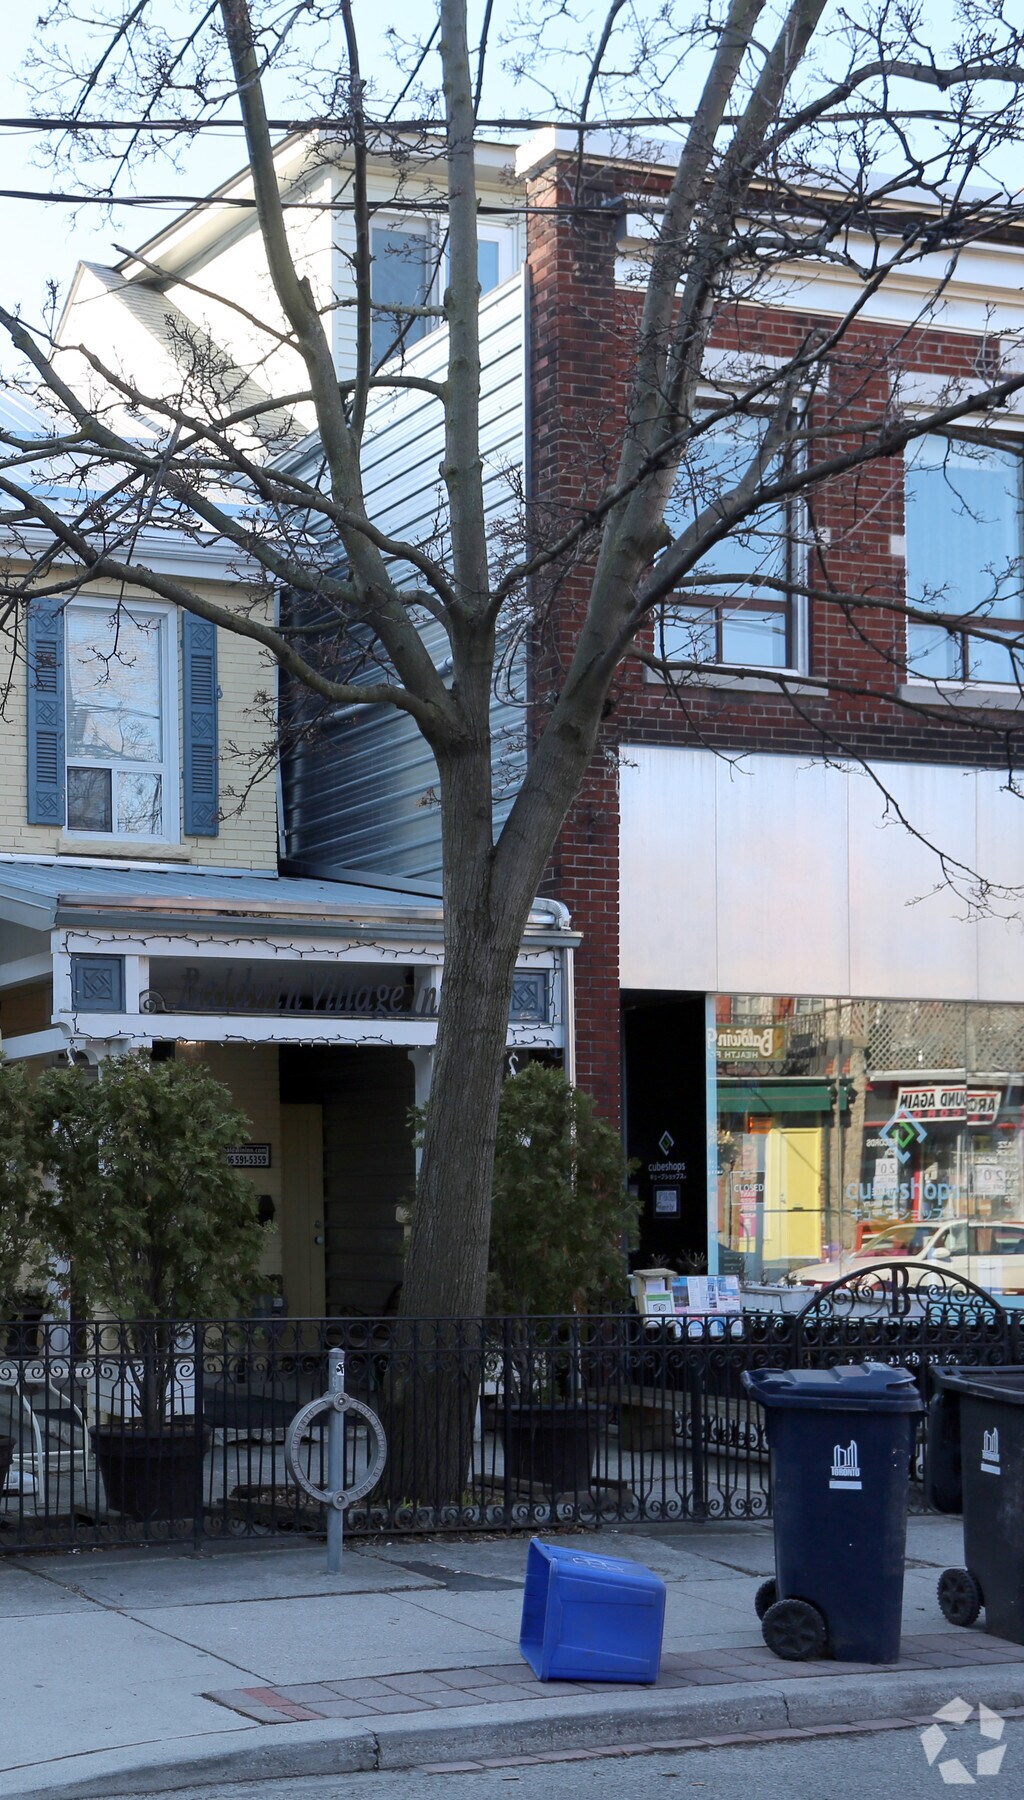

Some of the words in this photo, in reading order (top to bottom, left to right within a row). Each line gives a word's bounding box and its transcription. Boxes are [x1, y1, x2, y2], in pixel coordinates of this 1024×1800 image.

[180, 967, 303, 1010] Baldwin
[310, 971, 405, 1019] Village
[235, 1155, 267, 1164] 591-5359
[648, 1161, 686, 1172] cubeshops
[733, 1183, 764, 1193] CLOSED
[845, 1177, 961, 1205] cubeshops
[292, 1409, 315, 1451] TORONTO
[831, 1467, 861, 1477] TORONTO
